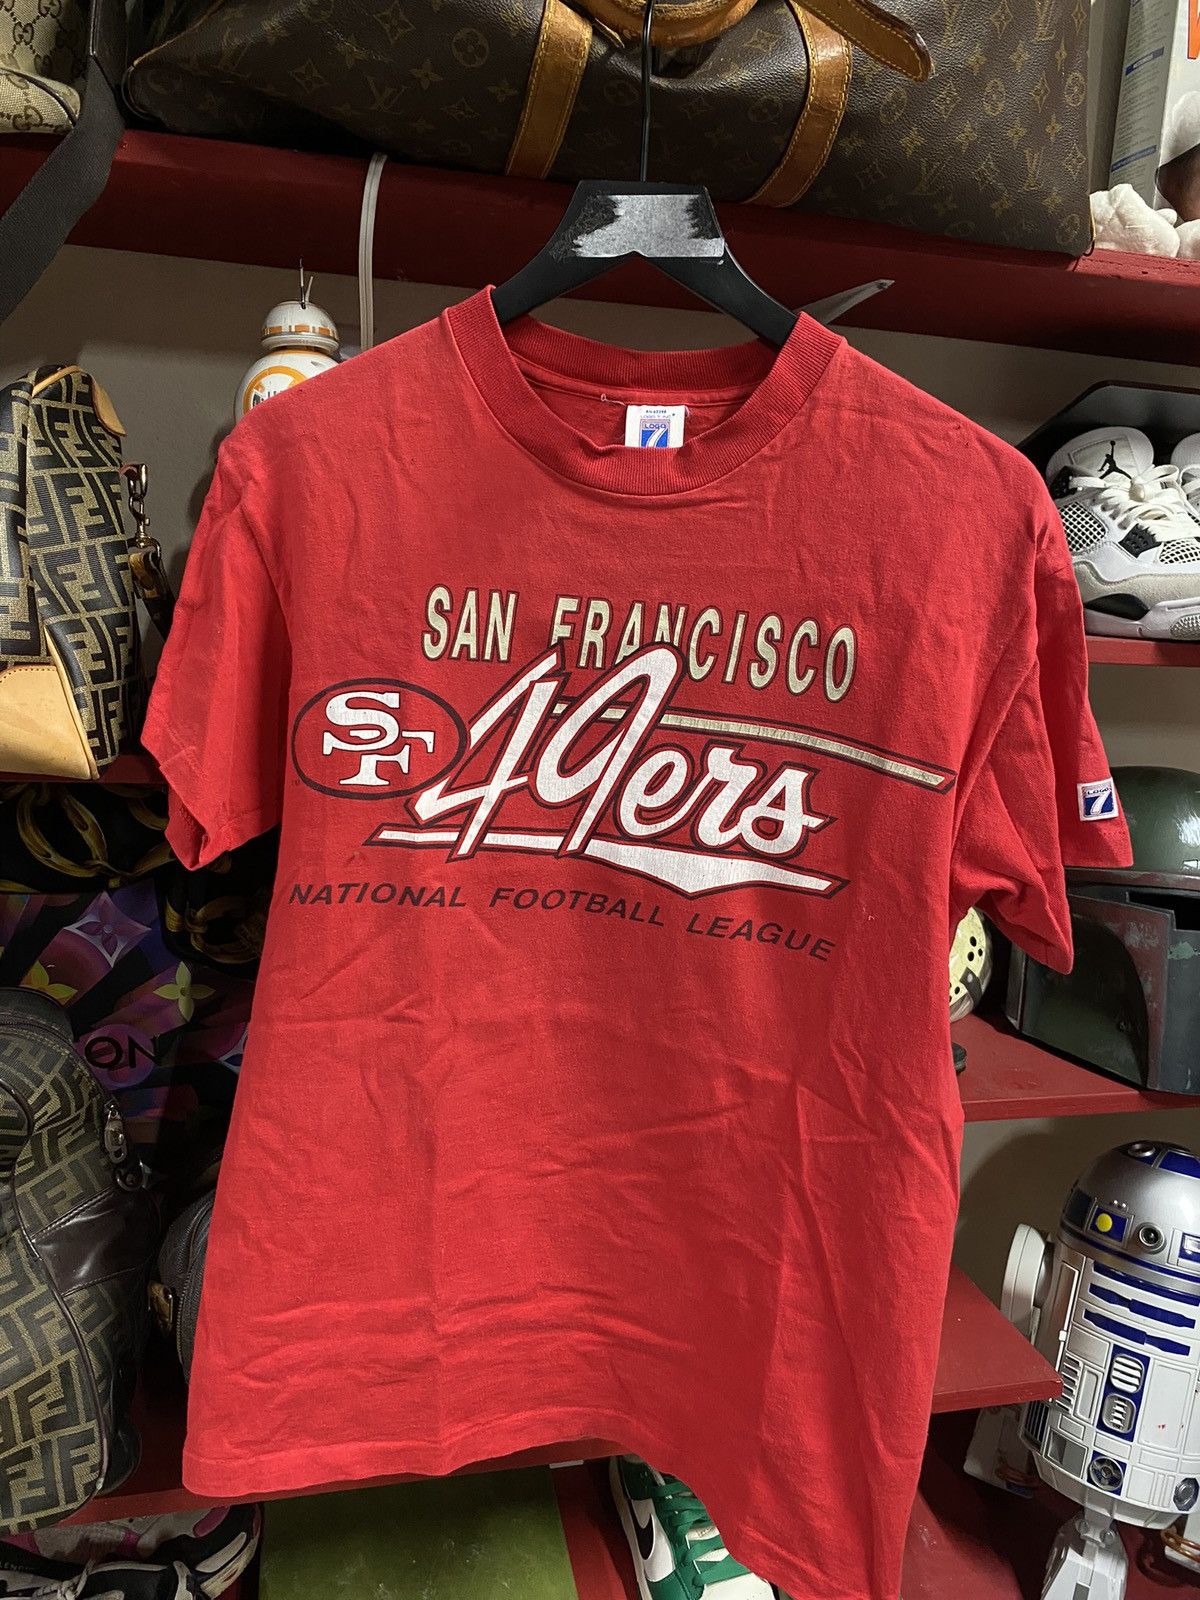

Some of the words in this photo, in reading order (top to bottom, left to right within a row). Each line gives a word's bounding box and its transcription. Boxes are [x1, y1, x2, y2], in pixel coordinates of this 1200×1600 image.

[422, 584, 519, 662] SAN
[550, 594, 859, 703] FRANCISCO
[322, 691, 435, 786] SF
[410, 645, 834, 861] 49ers
[289, 882, 467, 908] NATIONAL
[489, 887, 664, 927] FOOTBALL
[686, 912, 836, 962] LEAGUE
